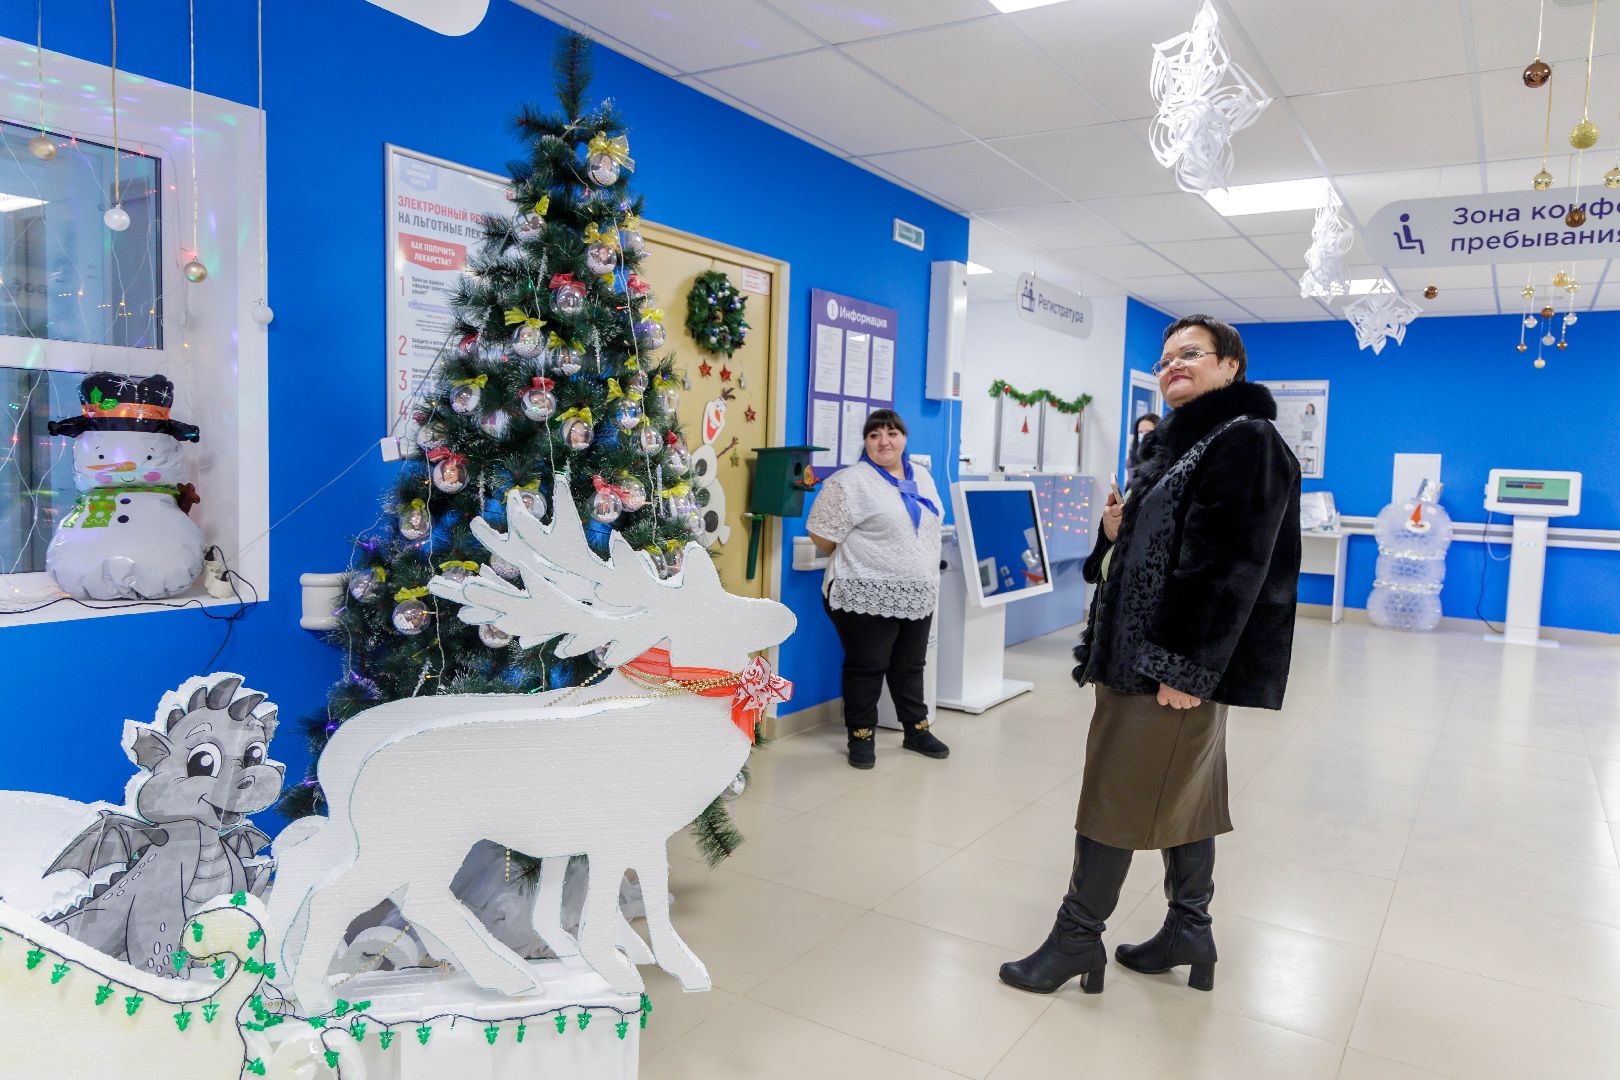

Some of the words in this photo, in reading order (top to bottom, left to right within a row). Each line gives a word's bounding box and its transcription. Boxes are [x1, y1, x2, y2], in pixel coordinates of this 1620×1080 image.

[398, 195, 467, 222] ЭЛЕКТРОННЫЙ
[1452, 207, 1520, 225] Зона
[1531, 197, 1620, 220] комф
[398, 211, 410, 224] НА
[412, 214, 462, 236] ЛЬГОТНЫЕ
[411, 241, 423, 250] КАК
[424, 243, 455, 256] ПОЛУЧИТЬ
[414, 253, 452, 266] ЛЕКАРСТВА?
[839, 306, 887, 328] Информация
[1037, 293, 1084, 323] Регистратура
[399, 335, 408, 355] 2
[399, 370, 407, 391] 3
